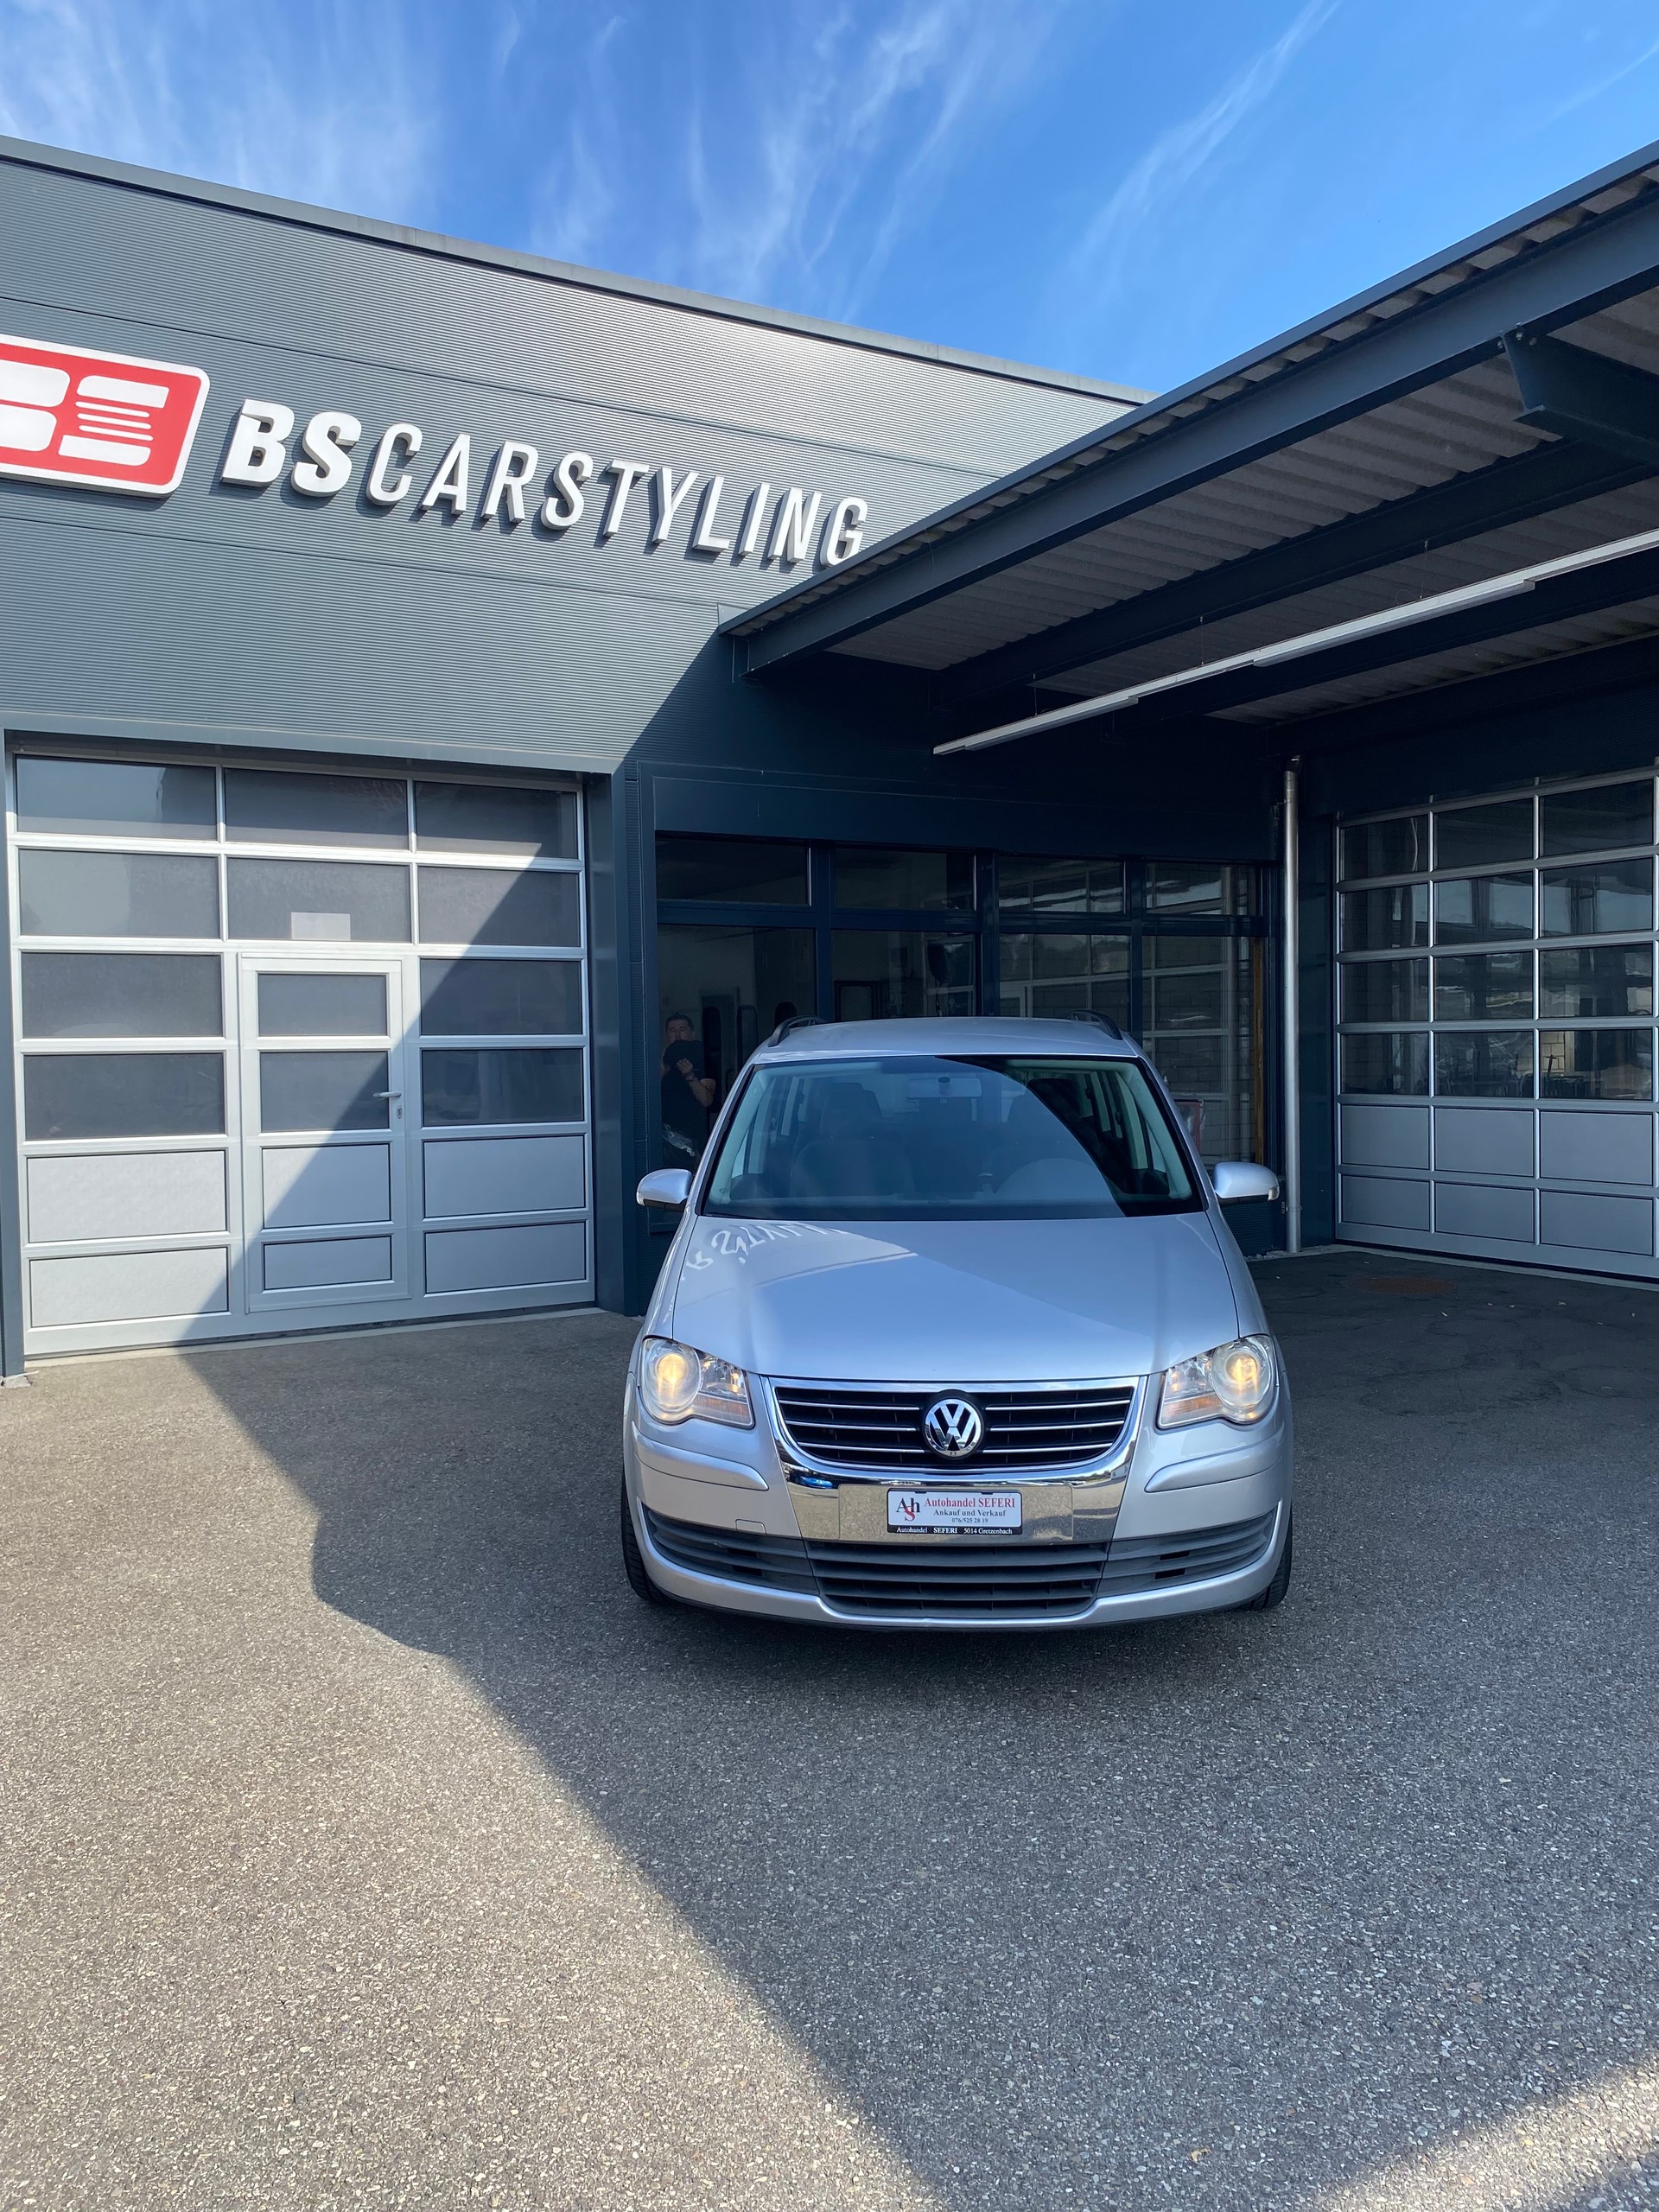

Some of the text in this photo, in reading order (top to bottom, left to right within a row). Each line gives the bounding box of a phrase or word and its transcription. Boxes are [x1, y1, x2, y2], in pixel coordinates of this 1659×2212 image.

[927, 1401, 979, 1455] VW
[924, 1497, 1015, 1508] Autohandel SEFERI
